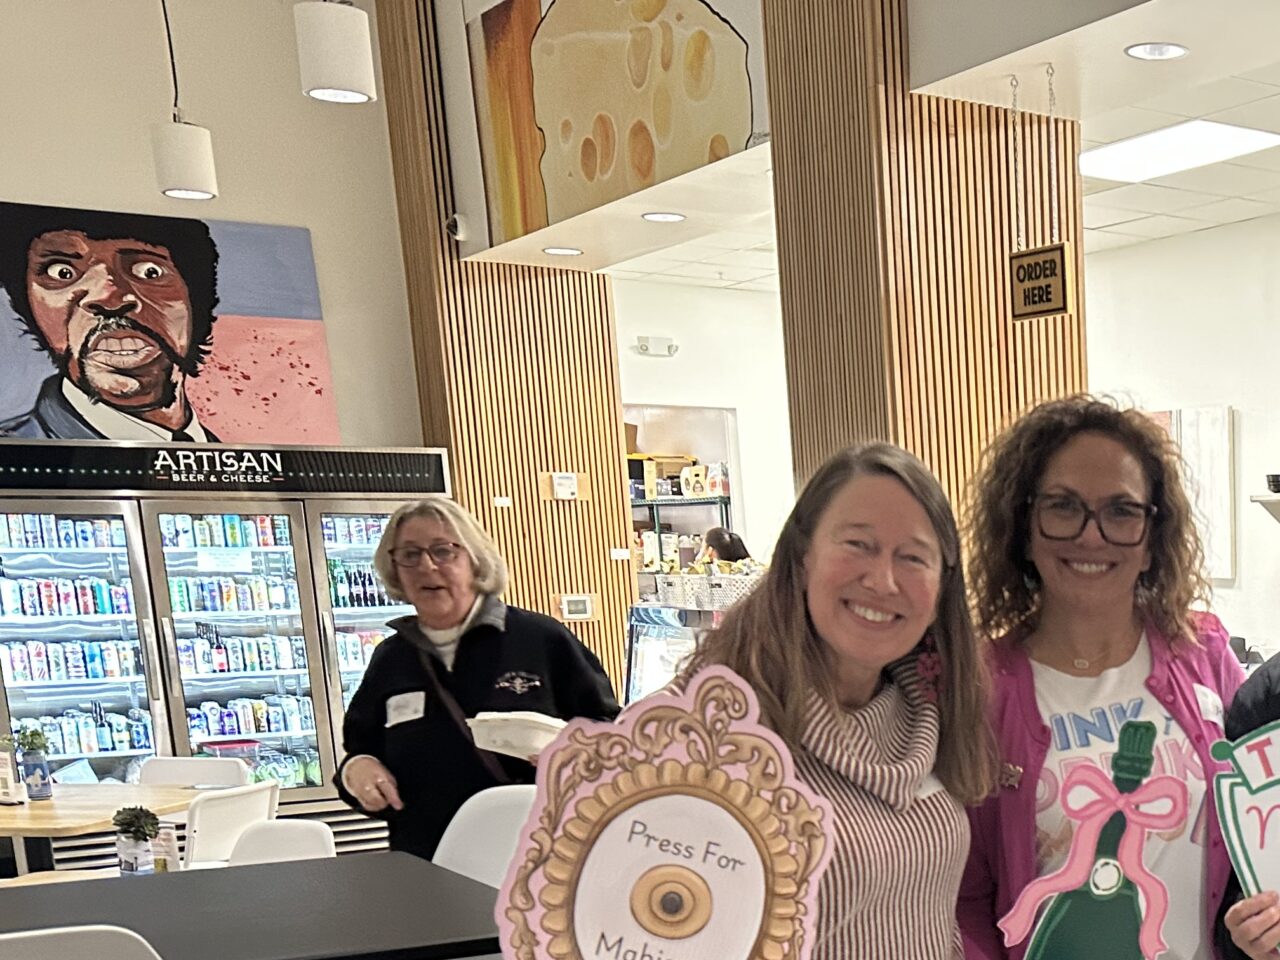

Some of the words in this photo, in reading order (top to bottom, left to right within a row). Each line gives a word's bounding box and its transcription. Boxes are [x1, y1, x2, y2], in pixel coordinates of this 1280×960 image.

[1016, 259, 1057, 283] ORDER
[1023, 284, 1052, 306] HERE
[154, 450, 283, 472] ARTISAN
[172, 474, 205, 482] BEER
[221, 474, 271, 483] CHEESE
[627, 820, 694, 861] Press
[699, 840, 745, 873] For
